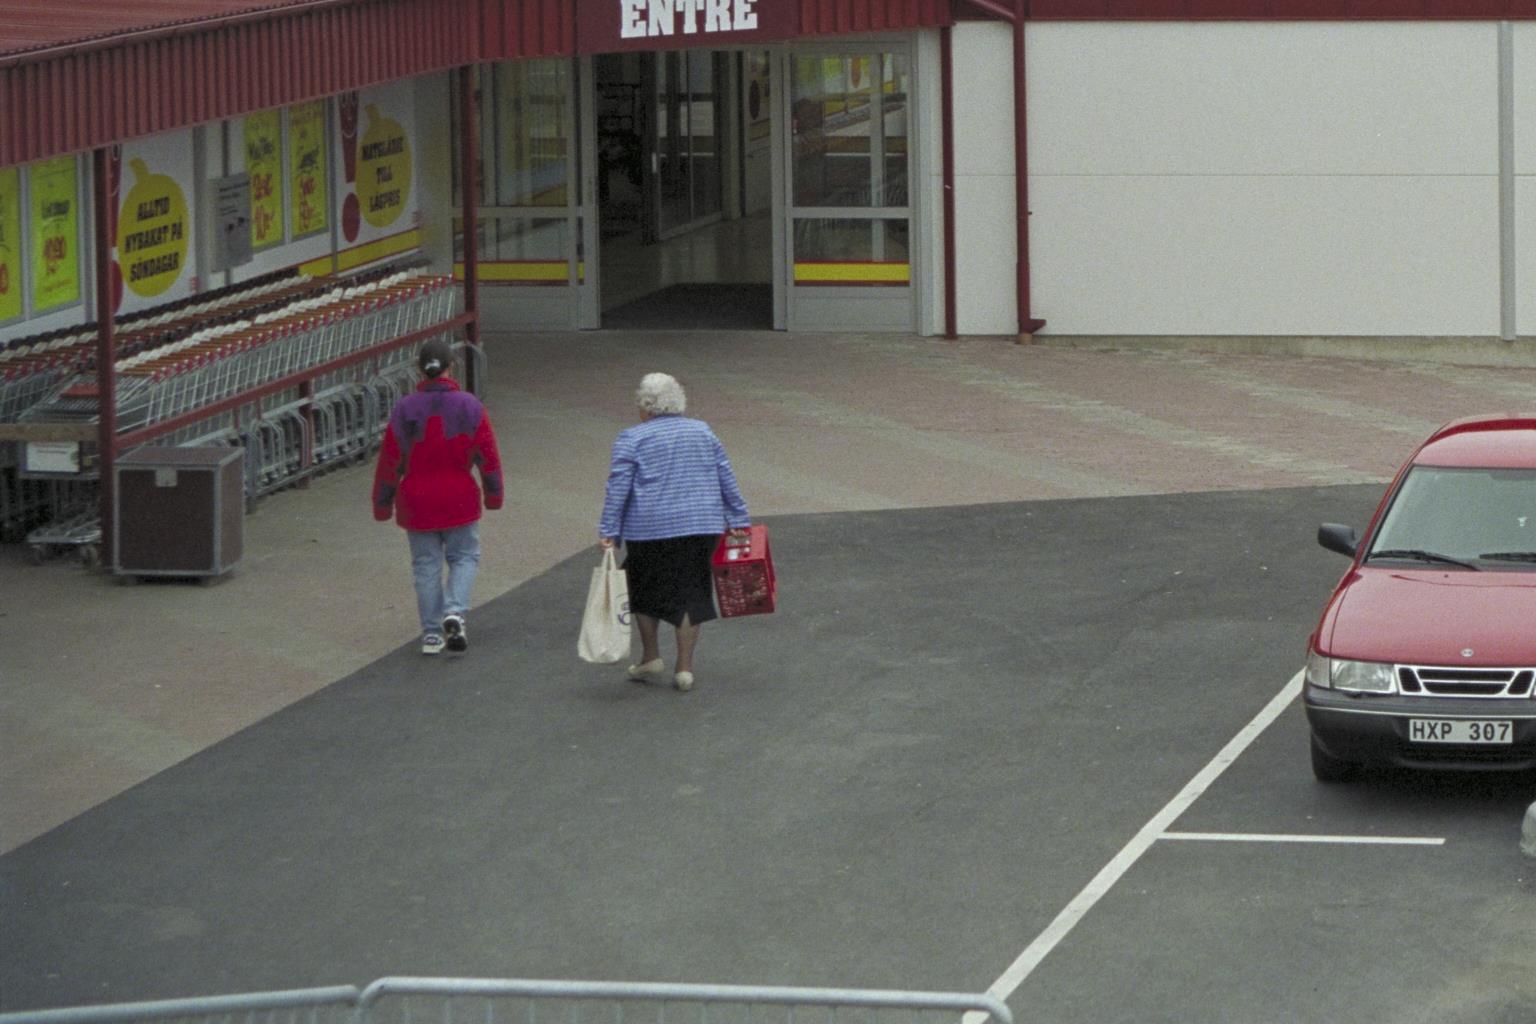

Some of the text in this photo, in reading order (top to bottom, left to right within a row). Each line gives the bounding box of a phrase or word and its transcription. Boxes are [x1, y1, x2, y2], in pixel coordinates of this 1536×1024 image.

[137, 196, 170, 222] ALLTID
[124, 224, 169, 254] NYBAKAT
[129, 250, 180, 283] SÖNDAGAR
[1412, 720, 1510, 741] HXP 307
